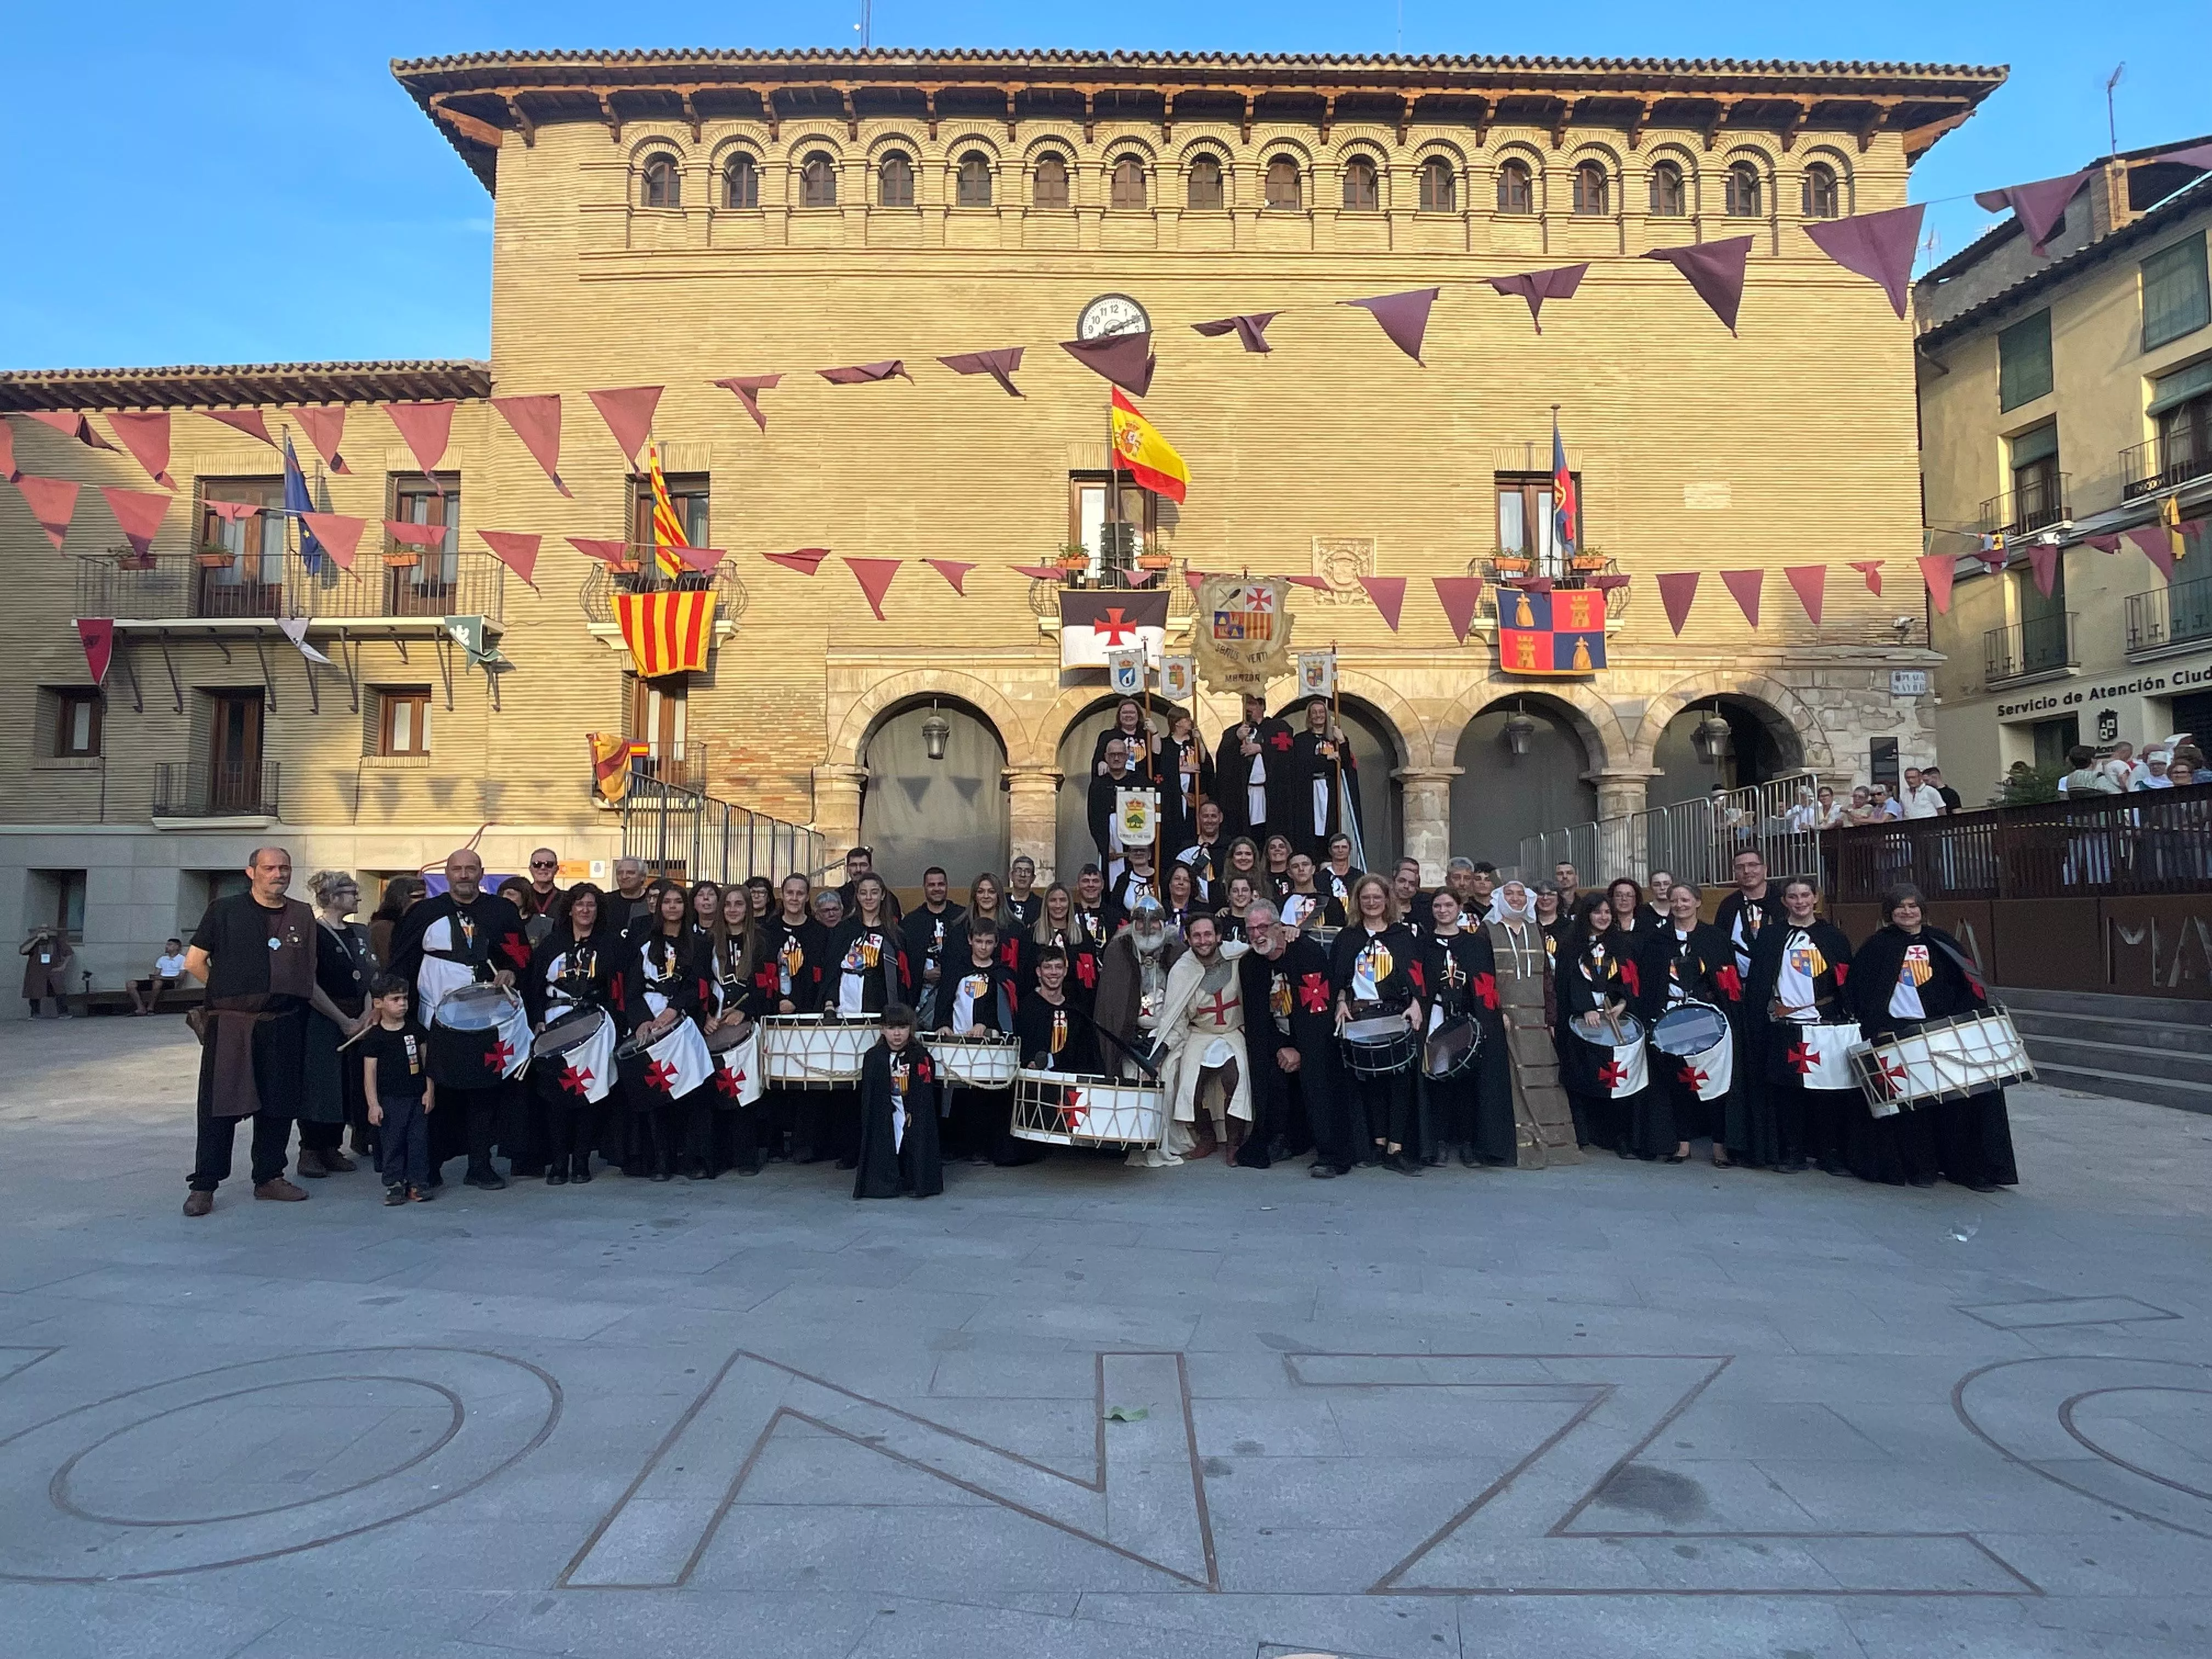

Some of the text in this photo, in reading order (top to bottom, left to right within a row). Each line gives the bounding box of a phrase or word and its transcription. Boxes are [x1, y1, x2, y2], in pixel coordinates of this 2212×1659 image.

[1100, 307, 1107, 316] 11
[1110, 304, 1119, 313] 12
[1091, 316, 1101, 324] 10
[1088, 325, 1093, 334] 9
[1997, 696, 2057, 716] Servicio
[2063, 692, 2083, 704] de
[2089, 677, 2165, 701] Atención
